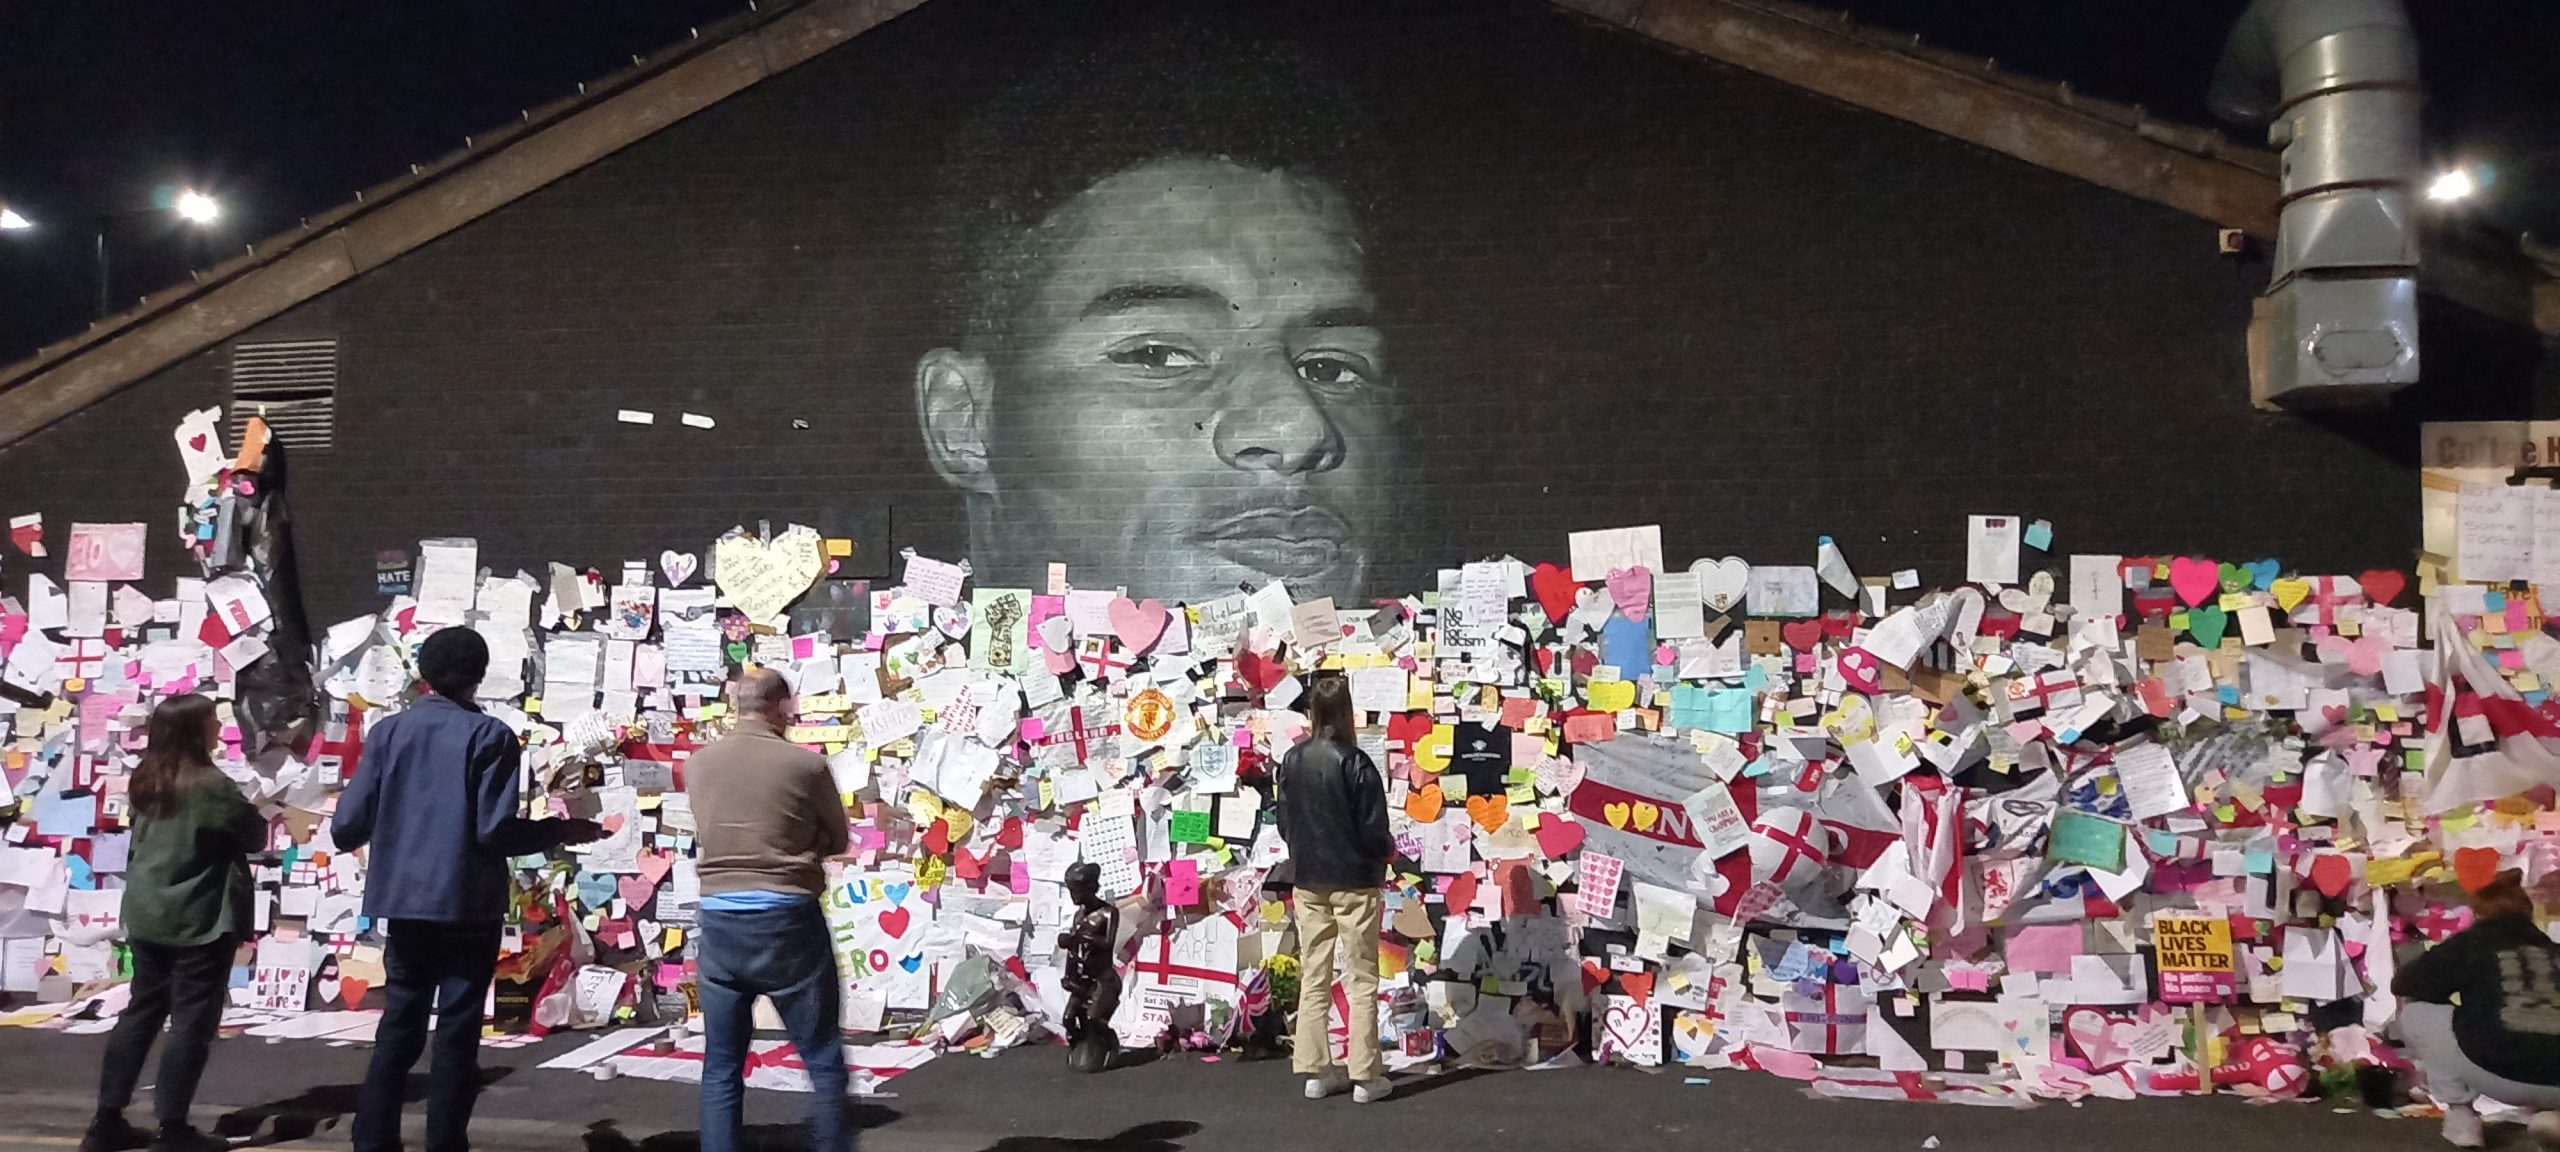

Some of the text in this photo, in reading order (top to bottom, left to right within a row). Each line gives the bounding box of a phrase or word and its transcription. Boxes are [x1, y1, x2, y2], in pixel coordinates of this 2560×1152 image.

[377, 570, 411, 583] HATE
[1444, 634, 1486, 647] racism
[2158, 919, 2212, 935] BLACK
[2160, 936, 2207, 951] LIVES
[2161, 952, 2229, 968] MATTER
[2159, 1061, 2251, 1080] ENGAND
